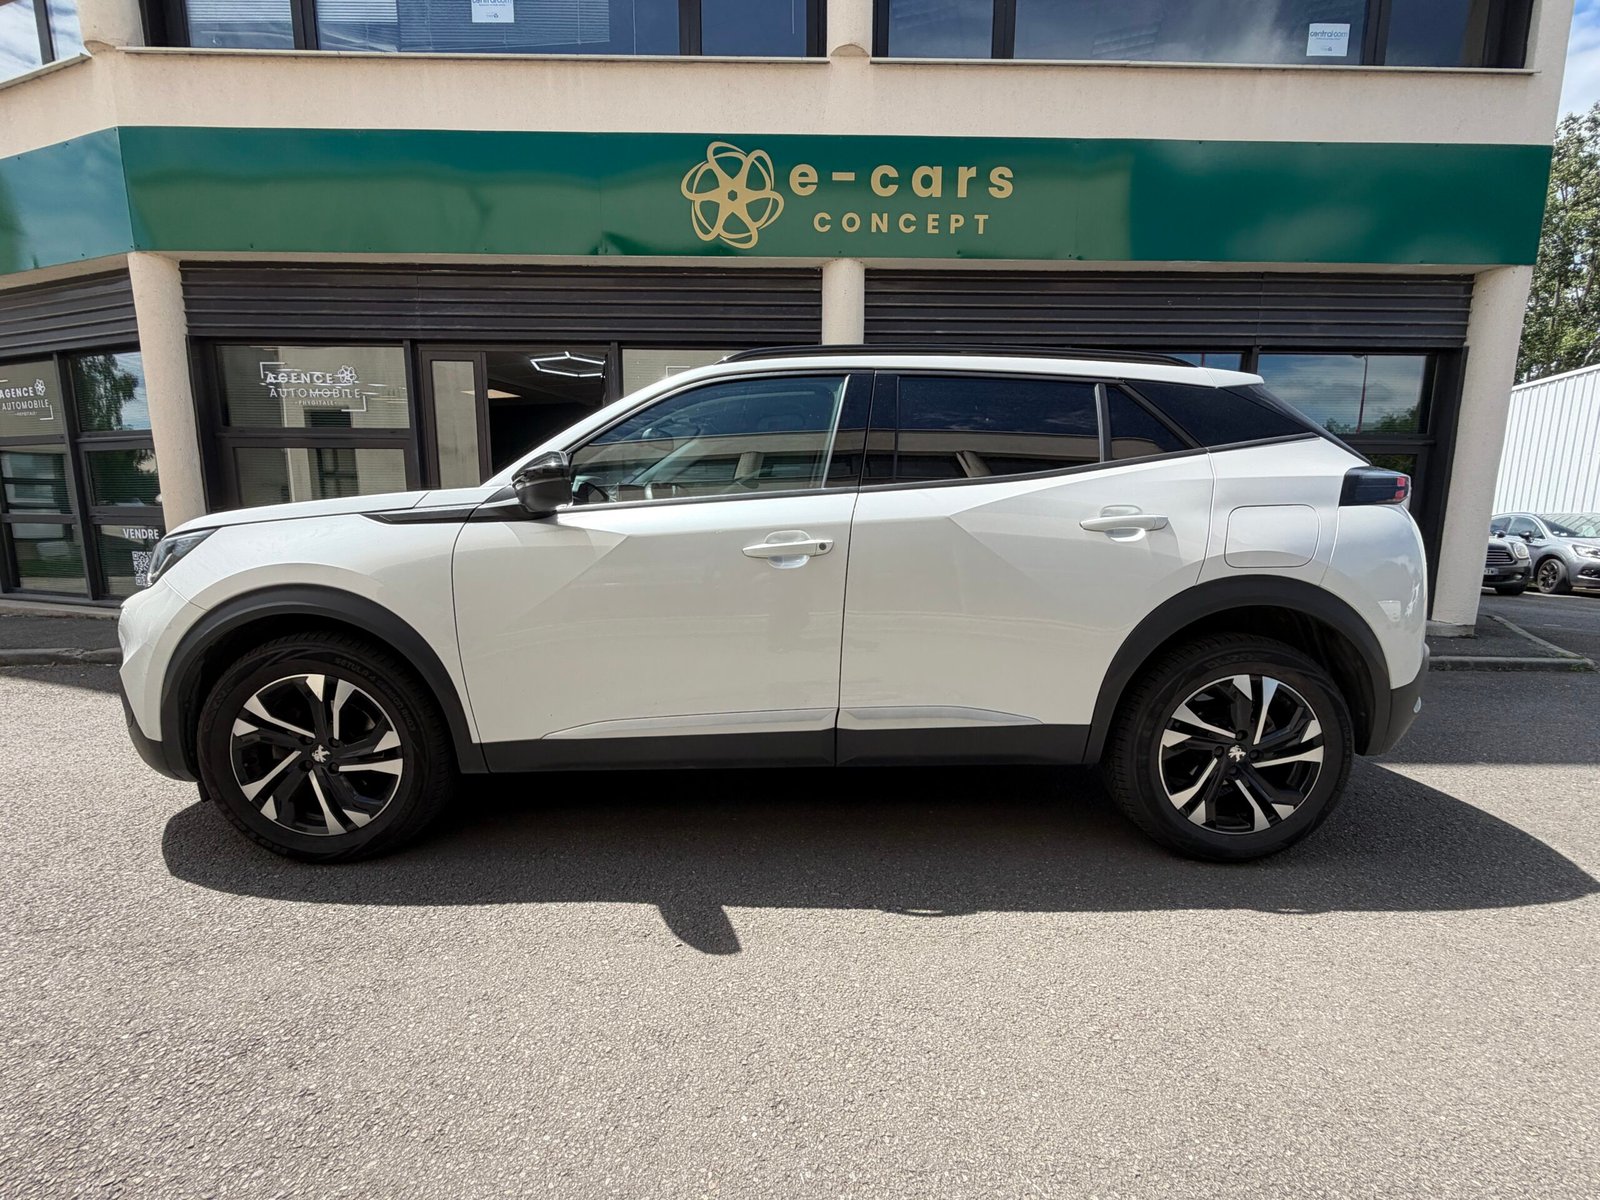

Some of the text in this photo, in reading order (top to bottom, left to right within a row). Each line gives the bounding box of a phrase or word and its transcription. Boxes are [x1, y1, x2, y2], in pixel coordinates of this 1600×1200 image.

[789, 163, 1014, 199] e-cars
[813, 212, 989, 235] CONCEPT
[266, 372, 334, 384] AGENCE
[0, 386, 34, 399] AGENCE
[269, 388, 361, 398] AUTOMOBILE
[2, 399, 49, 410] AUTOMOBILE
[122, 528, 160, 540] VENDRE
